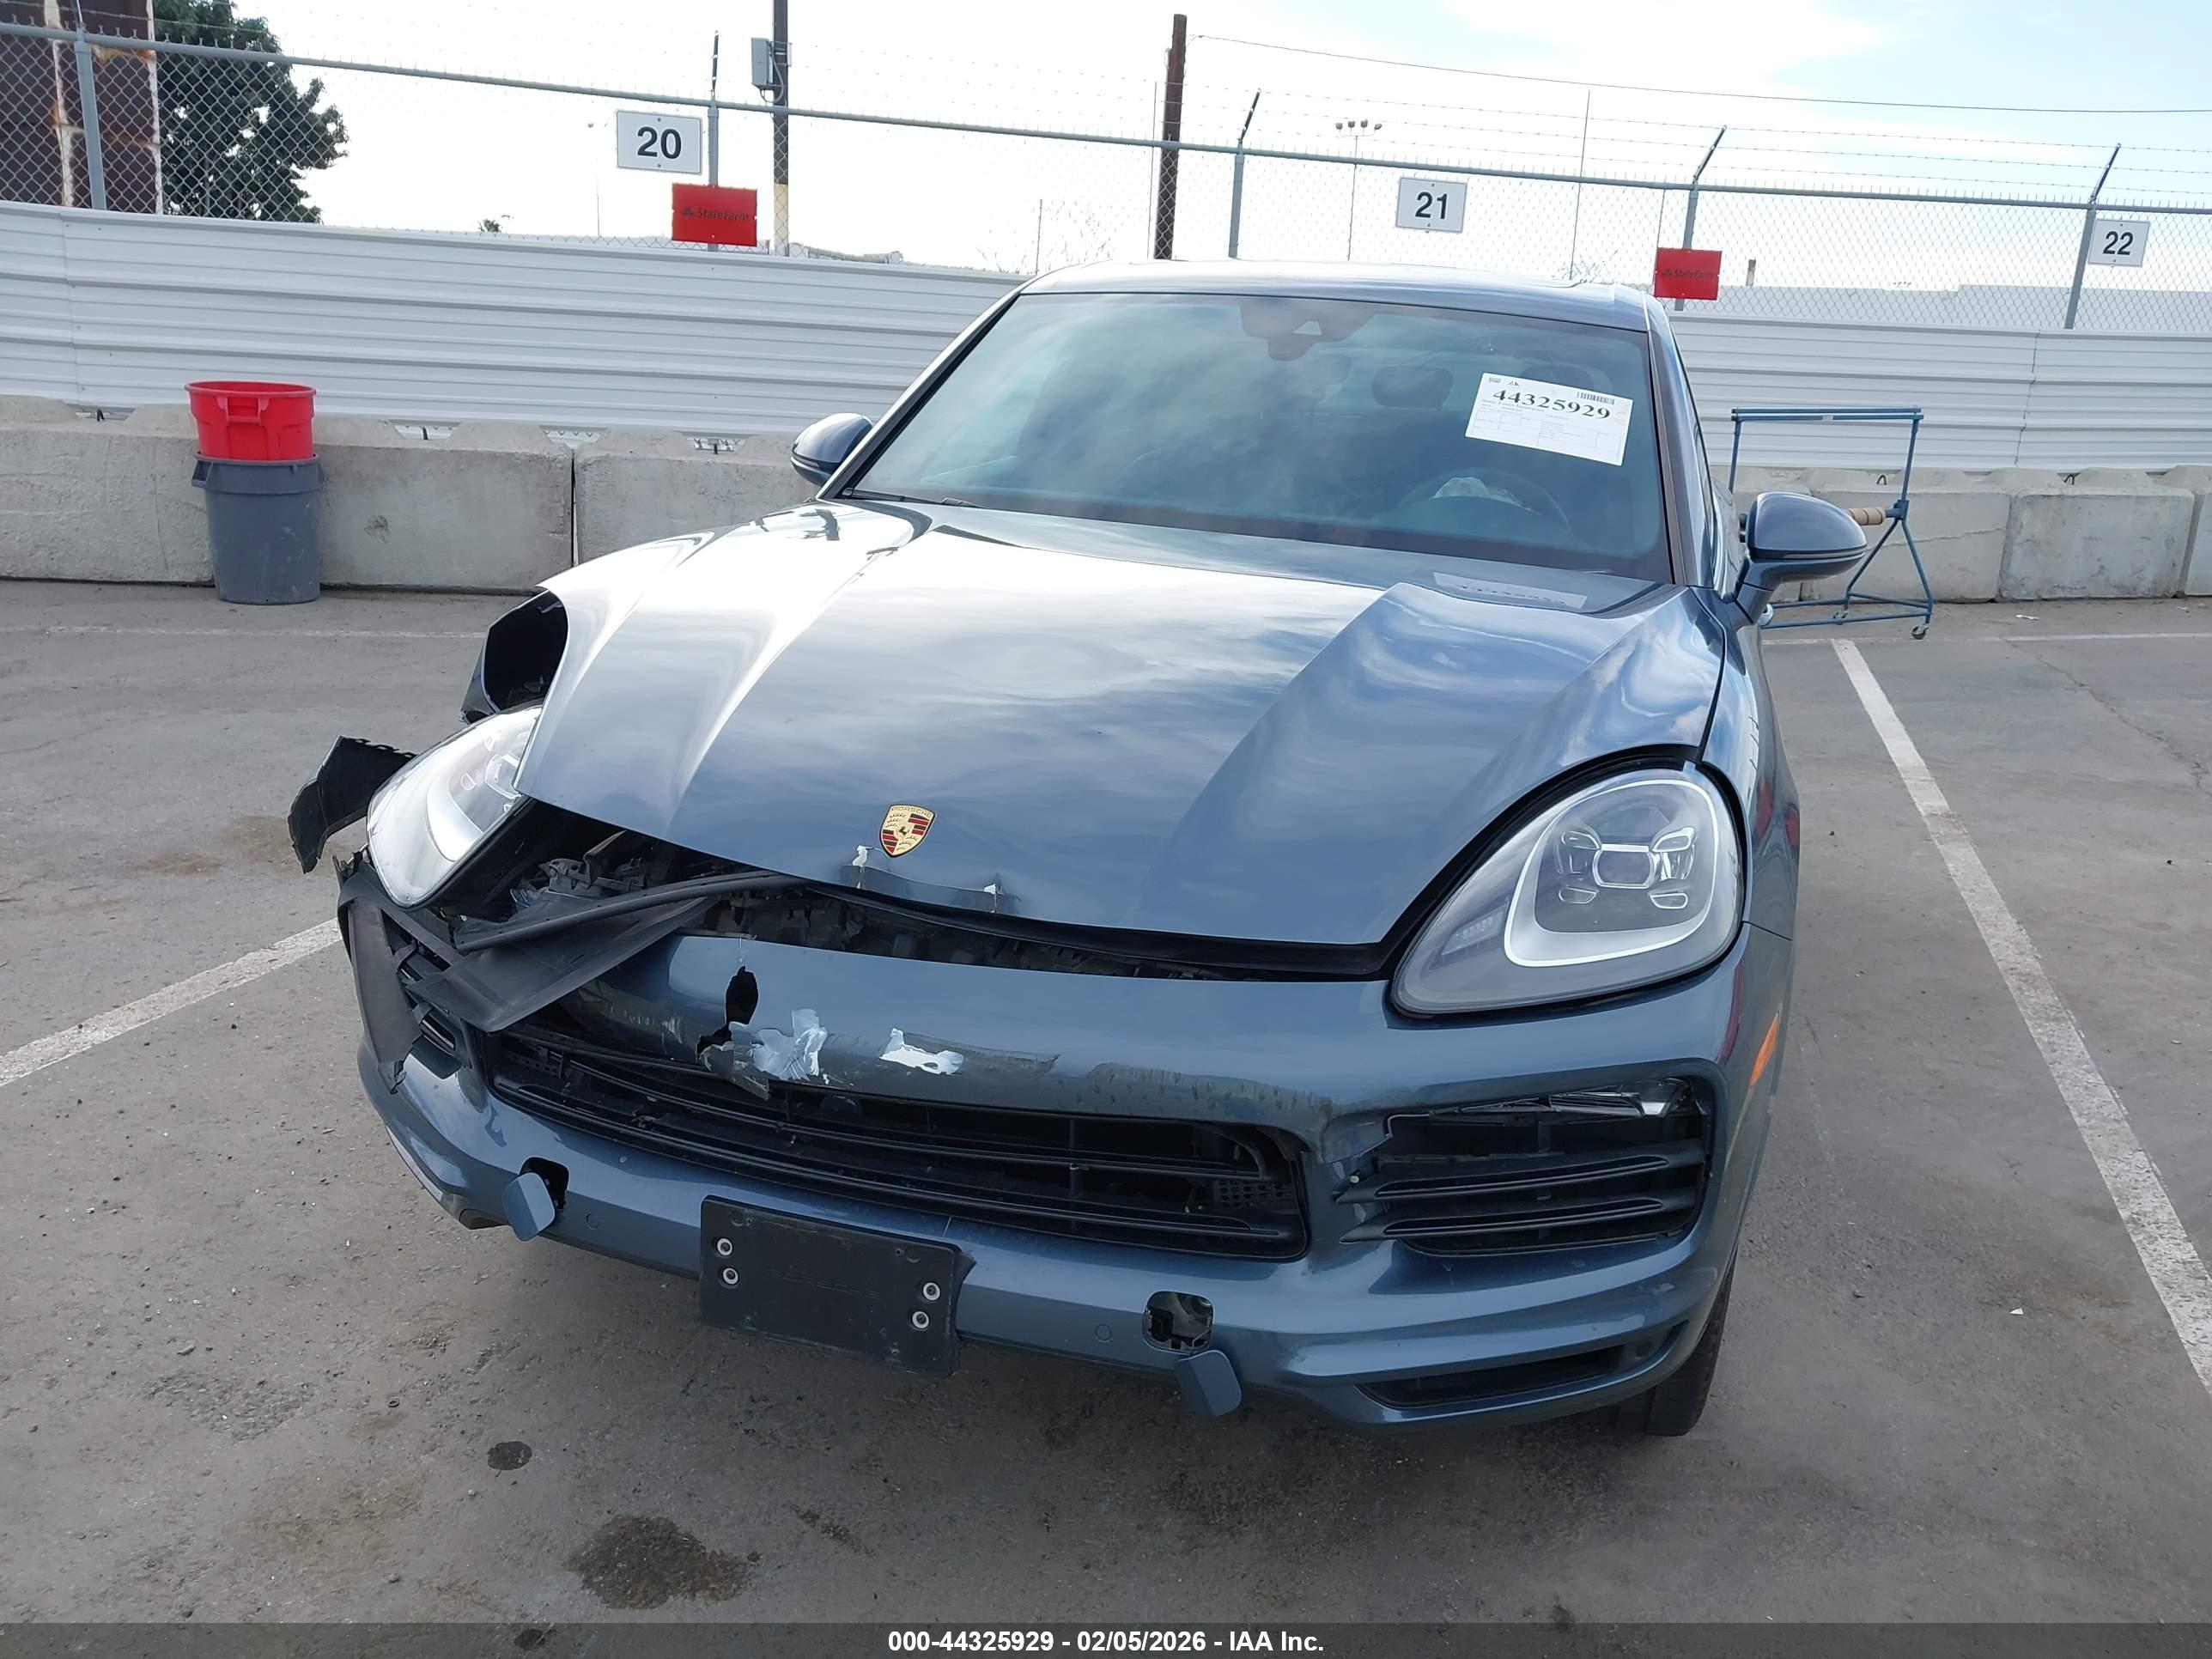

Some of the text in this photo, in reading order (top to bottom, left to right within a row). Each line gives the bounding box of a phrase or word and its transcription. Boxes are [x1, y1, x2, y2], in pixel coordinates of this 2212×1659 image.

[637, 126, 682, 159] 20
[1414, 191, 1448, 220] 21
[2102, 230, 2134, 256] 22
[1492, 388, 1611, 419] 44325929
[890, 806, 933, 819] PORSCHE
